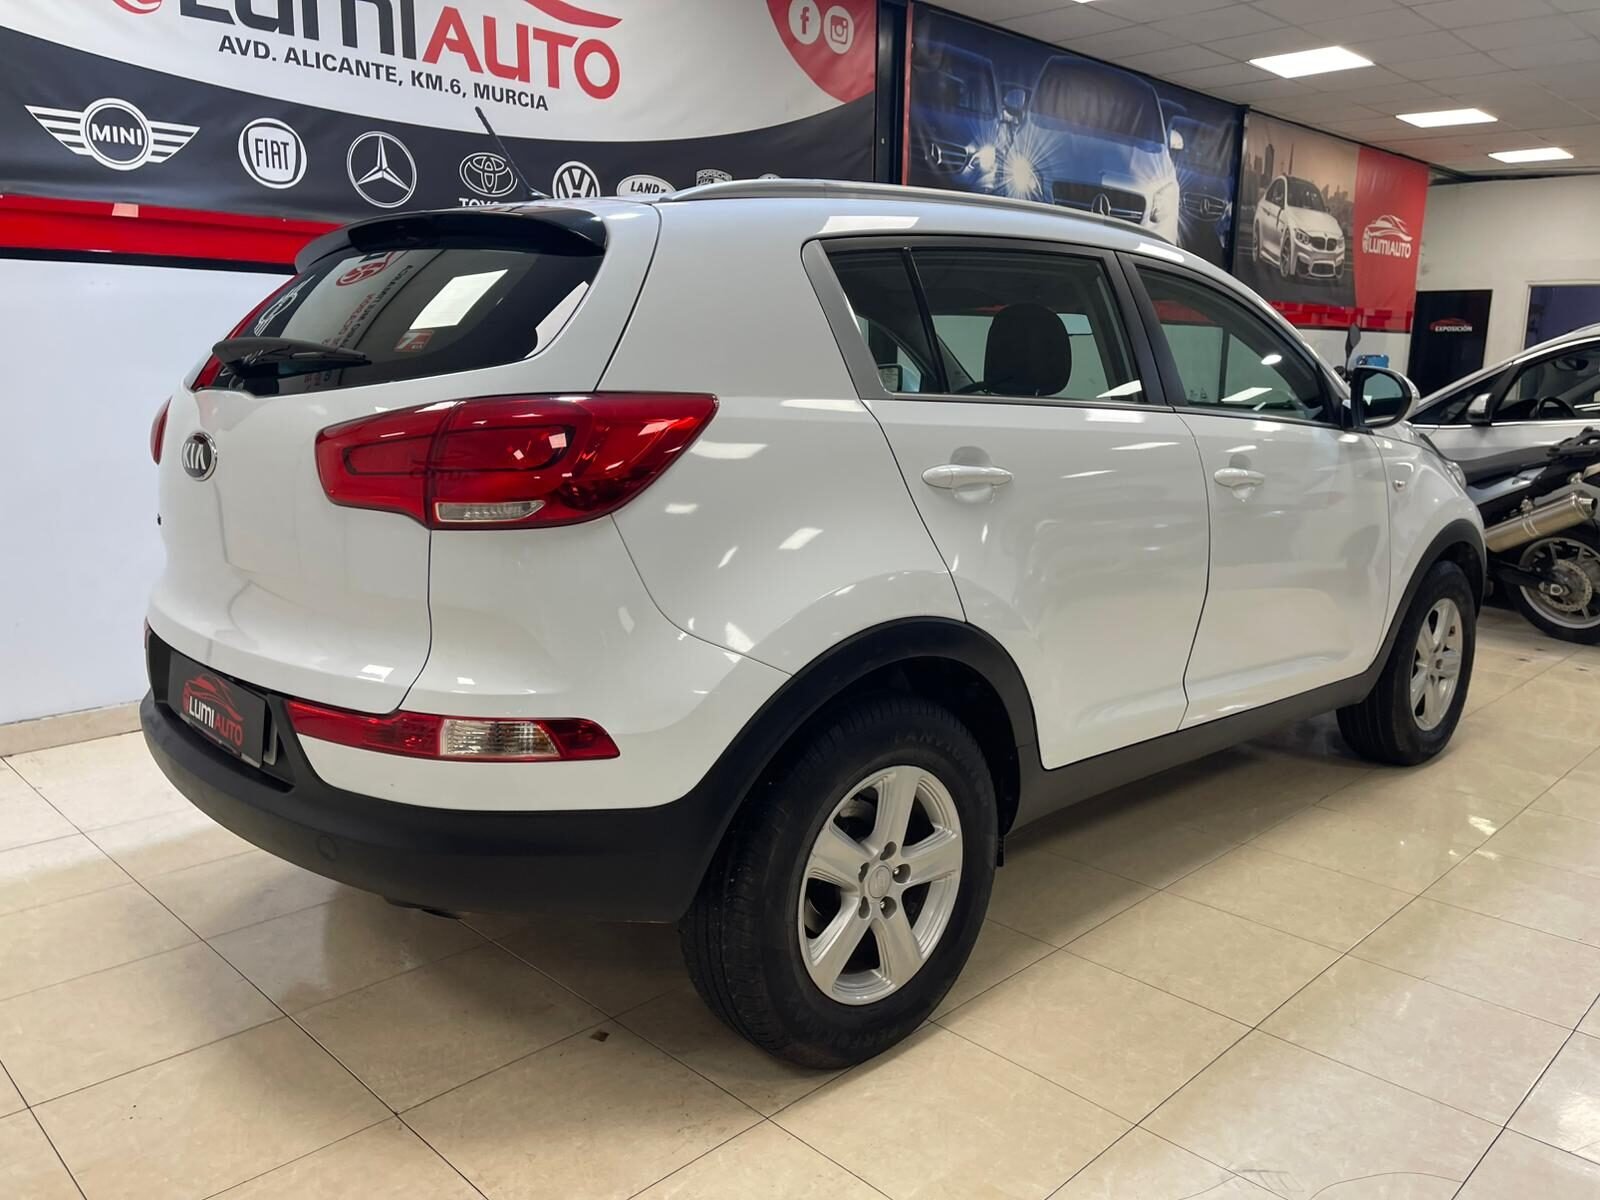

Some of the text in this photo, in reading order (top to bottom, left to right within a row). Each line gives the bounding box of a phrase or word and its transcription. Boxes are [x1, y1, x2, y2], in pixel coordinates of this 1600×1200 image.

[218, 35, 549, 111] AVD. ALICANTE, KM.6, MURCIA
[91, 123, 143, 146] MINI
[254, 138, 289, 170] FIAT
[630, 181, 660, 195] LAND
[183, 442, 207, 470] KIA
